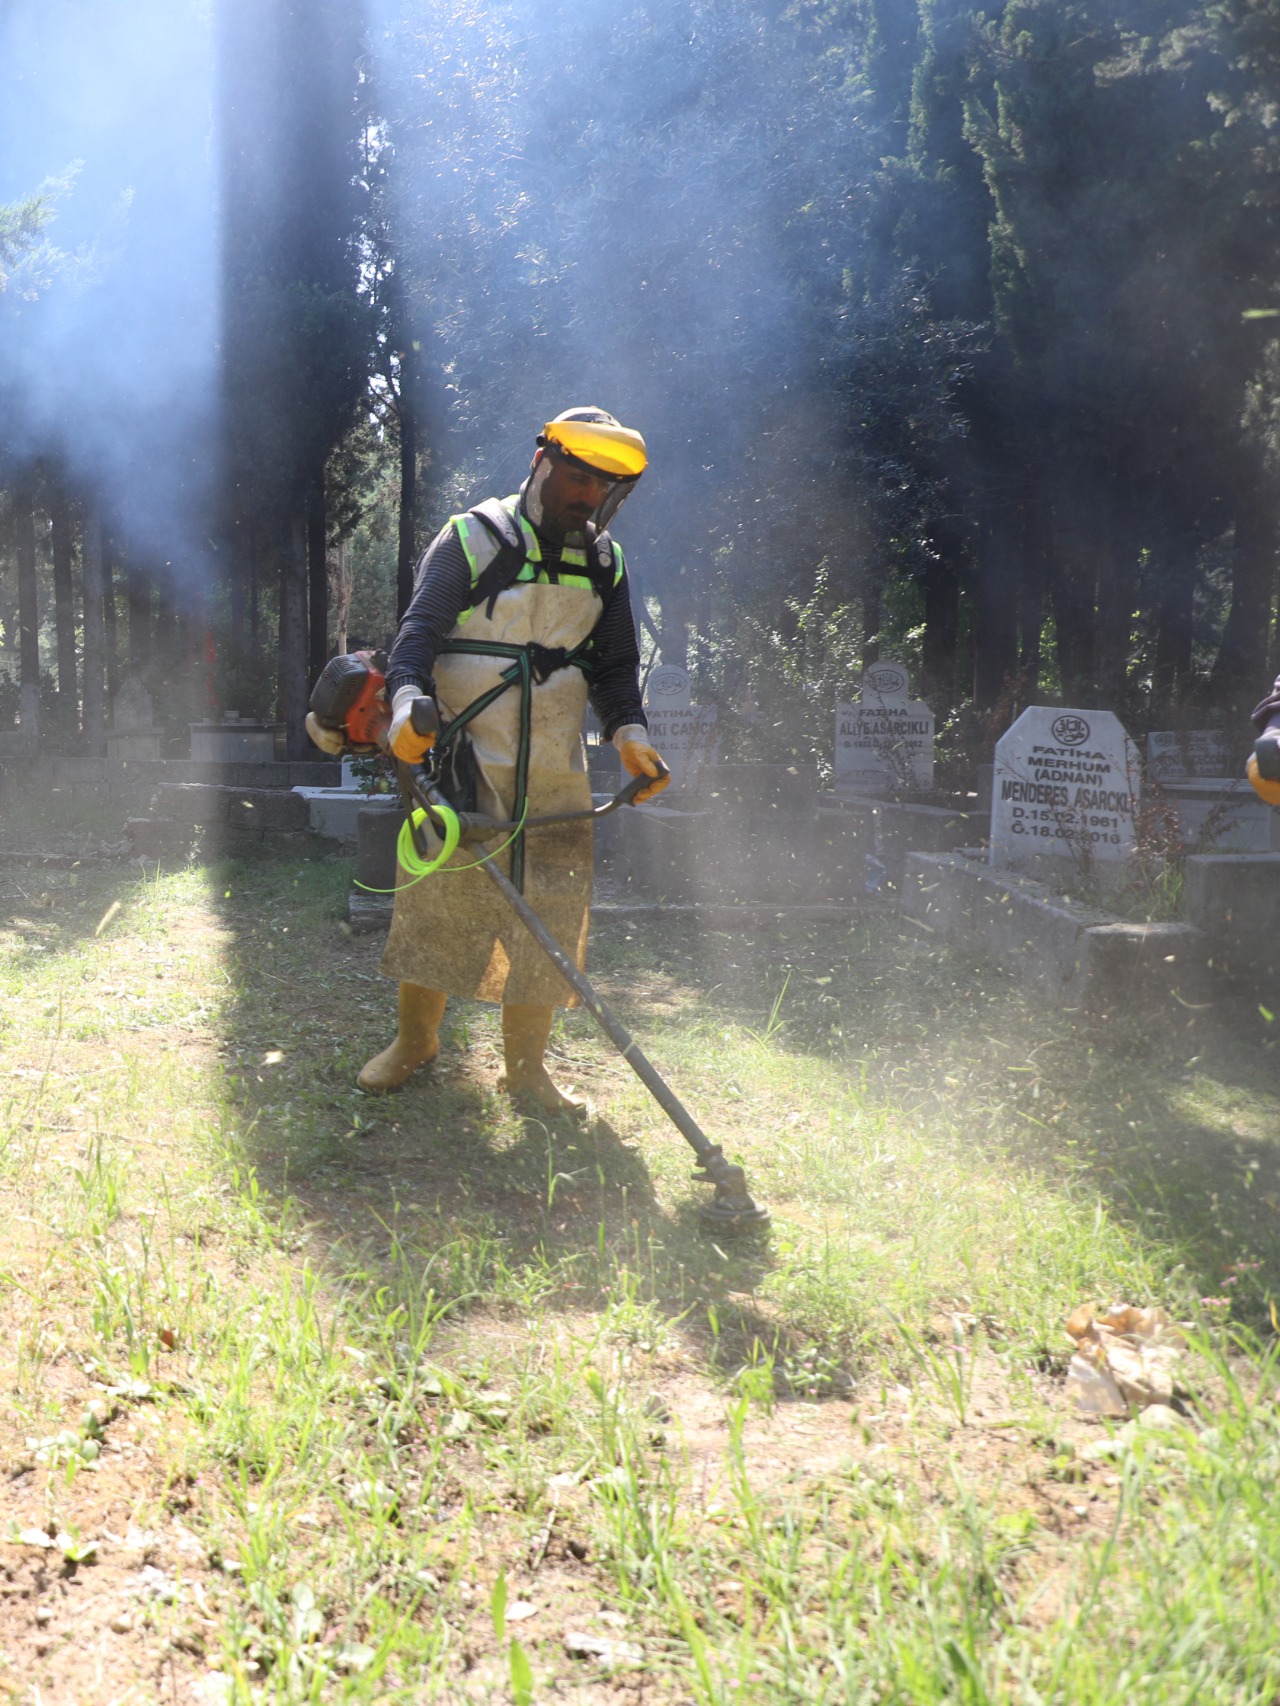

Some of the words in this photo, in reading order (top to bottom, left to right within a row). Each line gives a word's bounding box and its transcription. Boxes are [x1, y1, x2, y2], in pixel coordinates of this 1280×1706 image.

[1032, 745, 1106, 760] FATİHA
[1027, 756, 1111, 774] MERHUM
[1034, 768, 1103, 788] (ADNAN)
[1001, 780, 1069, 807] MENDERES
